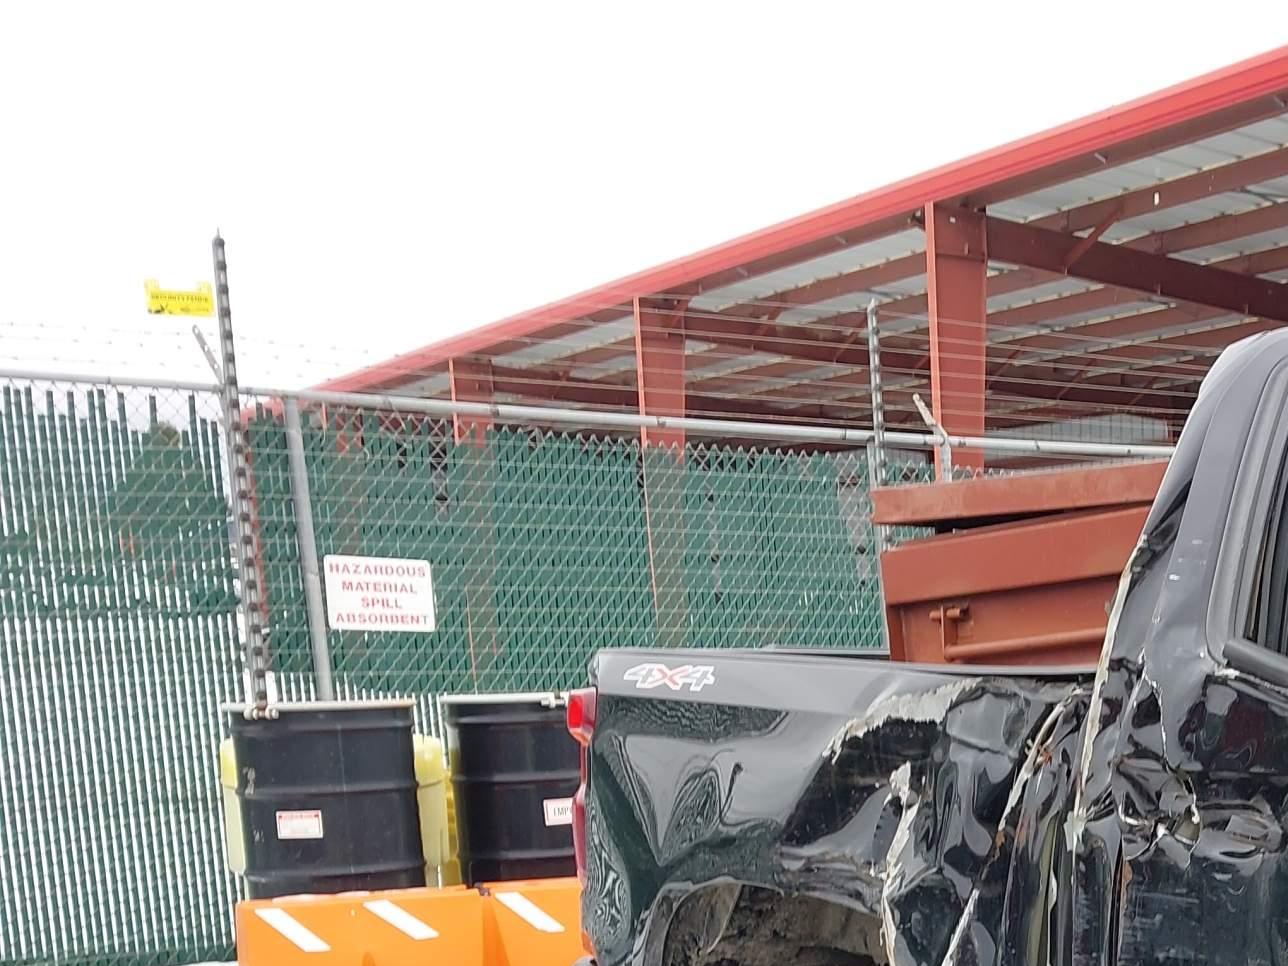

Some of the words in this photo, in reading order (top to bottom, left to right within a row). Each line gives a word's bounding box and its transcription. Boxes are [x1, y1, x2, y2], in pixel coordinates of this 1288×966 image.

[329, 563, 426, 577] HAZARDOUS
[342, 581, 417, 594] MATERIAL
[361, 597, 403, 609] SPILL
[336, 612, 430, 626] ABSORBENT
